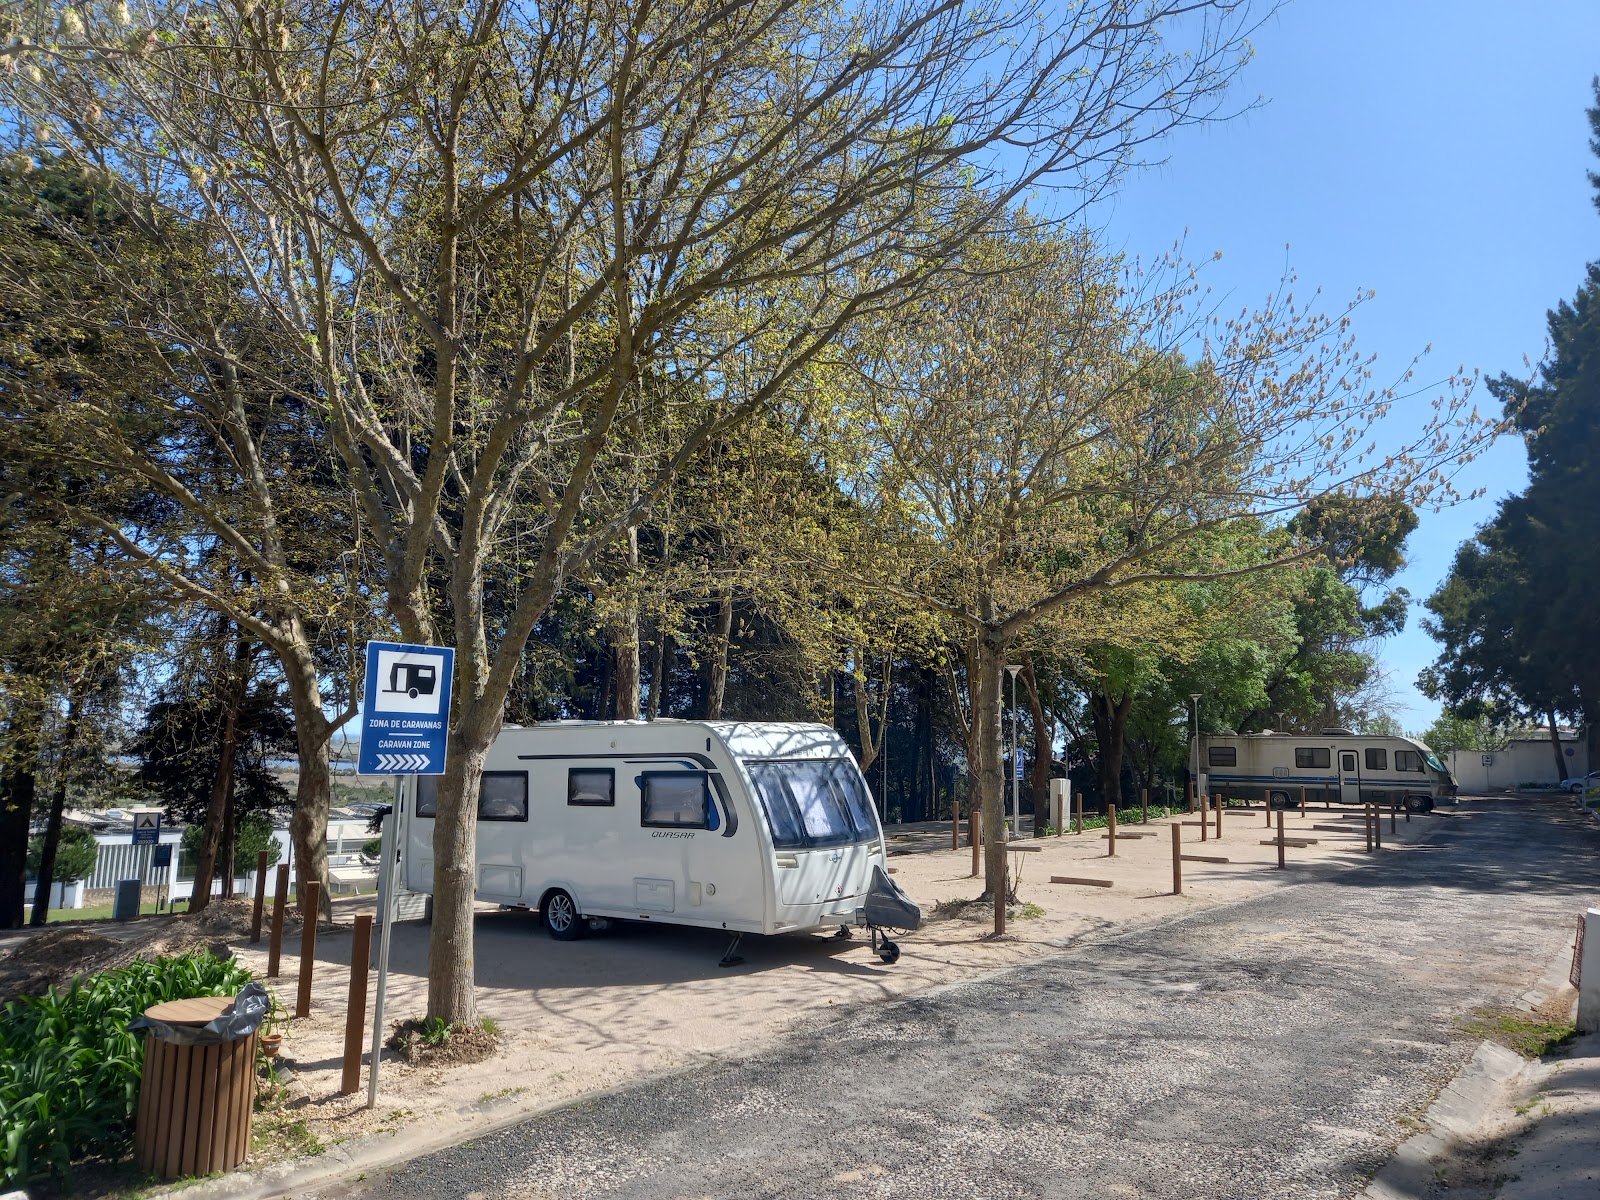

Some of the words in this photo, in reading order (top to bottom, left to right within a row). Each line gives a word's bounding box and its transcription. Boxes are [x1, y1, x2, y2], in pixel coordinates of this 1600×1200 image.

[369, 719, 389, 728] ZONA
[390, 720, 401, 728] DE
[401, 720, 442, 729] CARAVANAS
[378, 740, 412, 749] CARAVAN
[413, 740, 431, 749] ZONE
[651, 830, 696, 839] QUASAR
